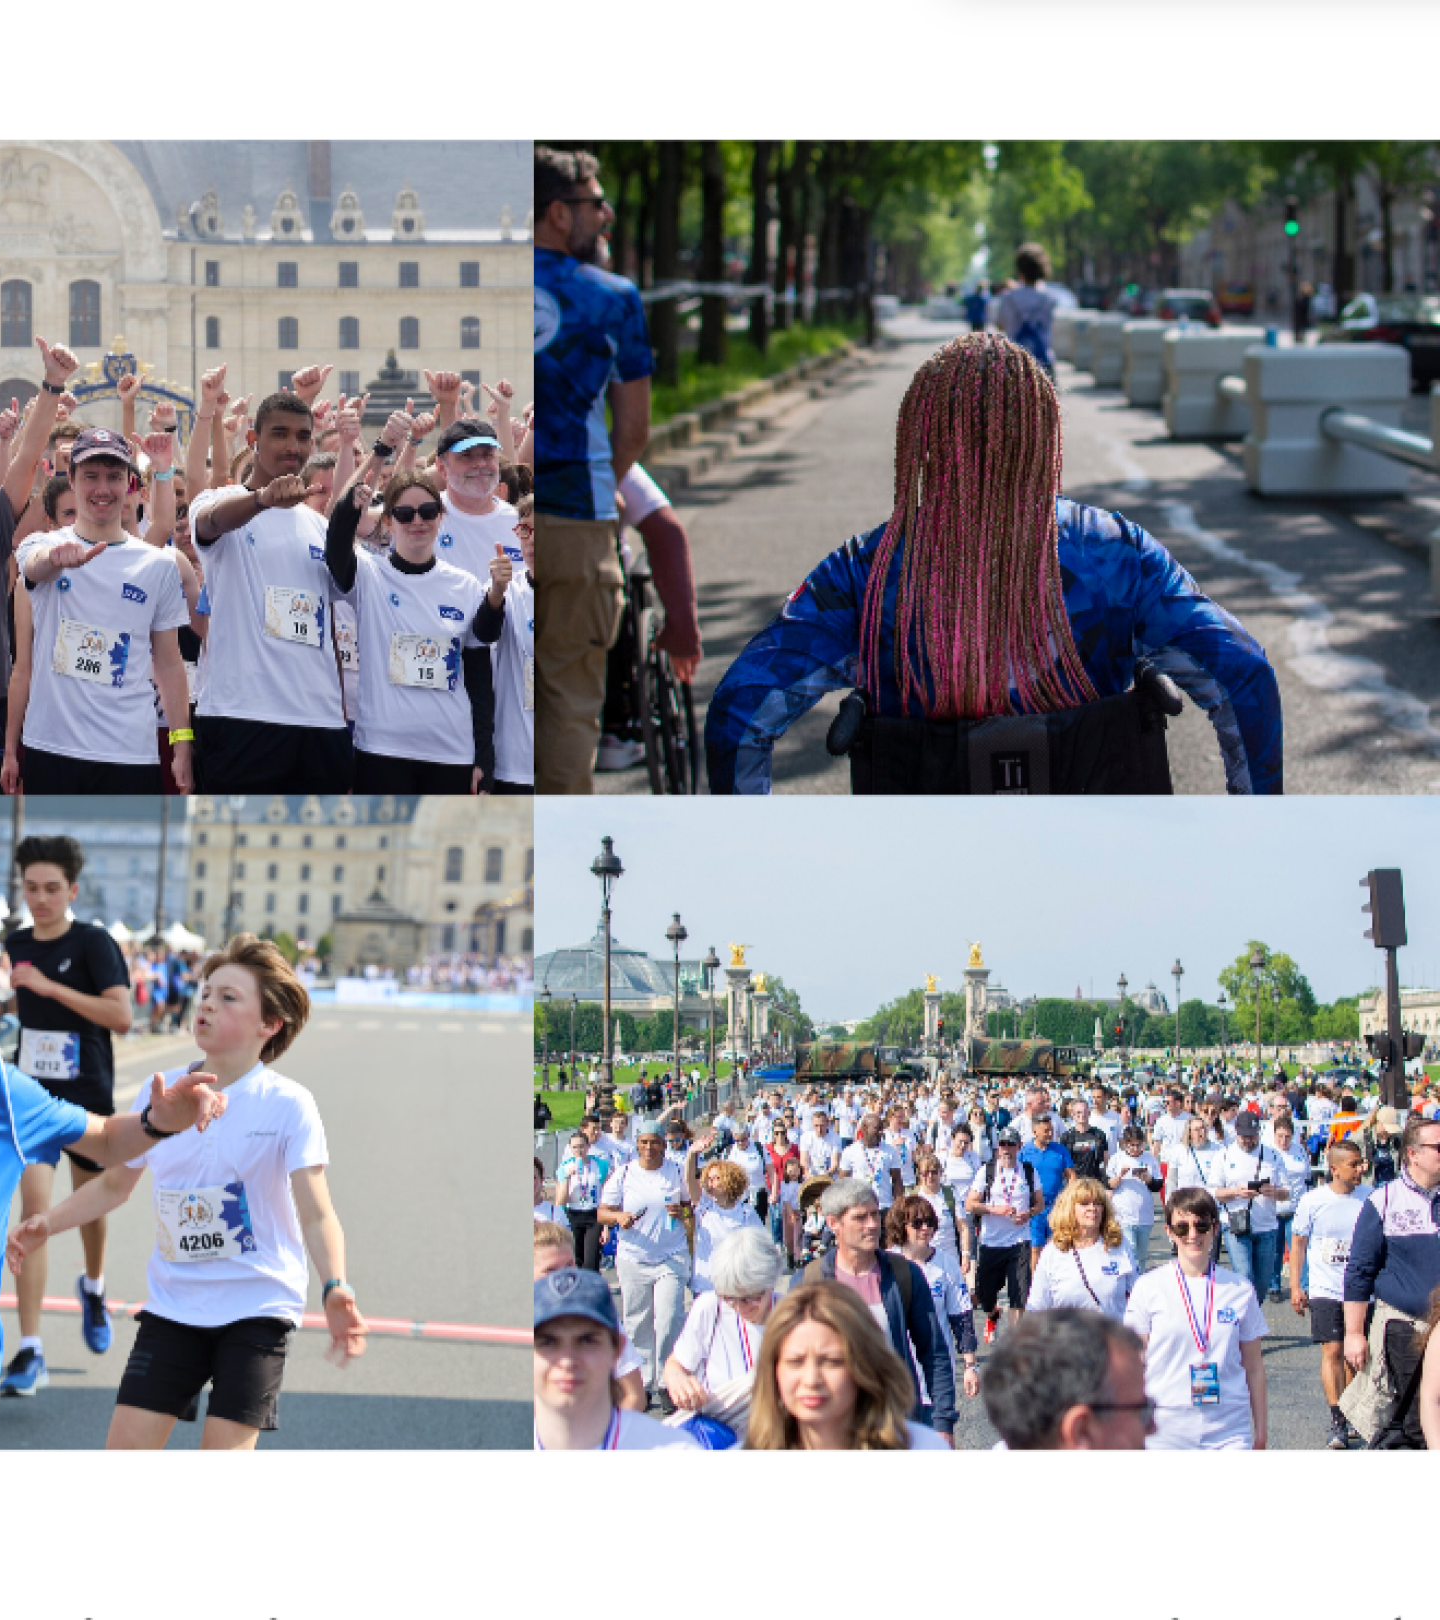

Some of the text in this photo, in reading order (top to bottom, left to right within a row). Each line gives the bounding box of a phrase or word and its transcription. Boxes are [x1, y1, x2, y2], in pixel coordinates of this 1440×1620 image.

[293, 621, 308, 636] 16
[75, 656, 102, 675] 286
[418, 667, 435, 680] 15
[998, 757, 1022, 787] Ti
[179, 1231, 225, 1252] 4206
